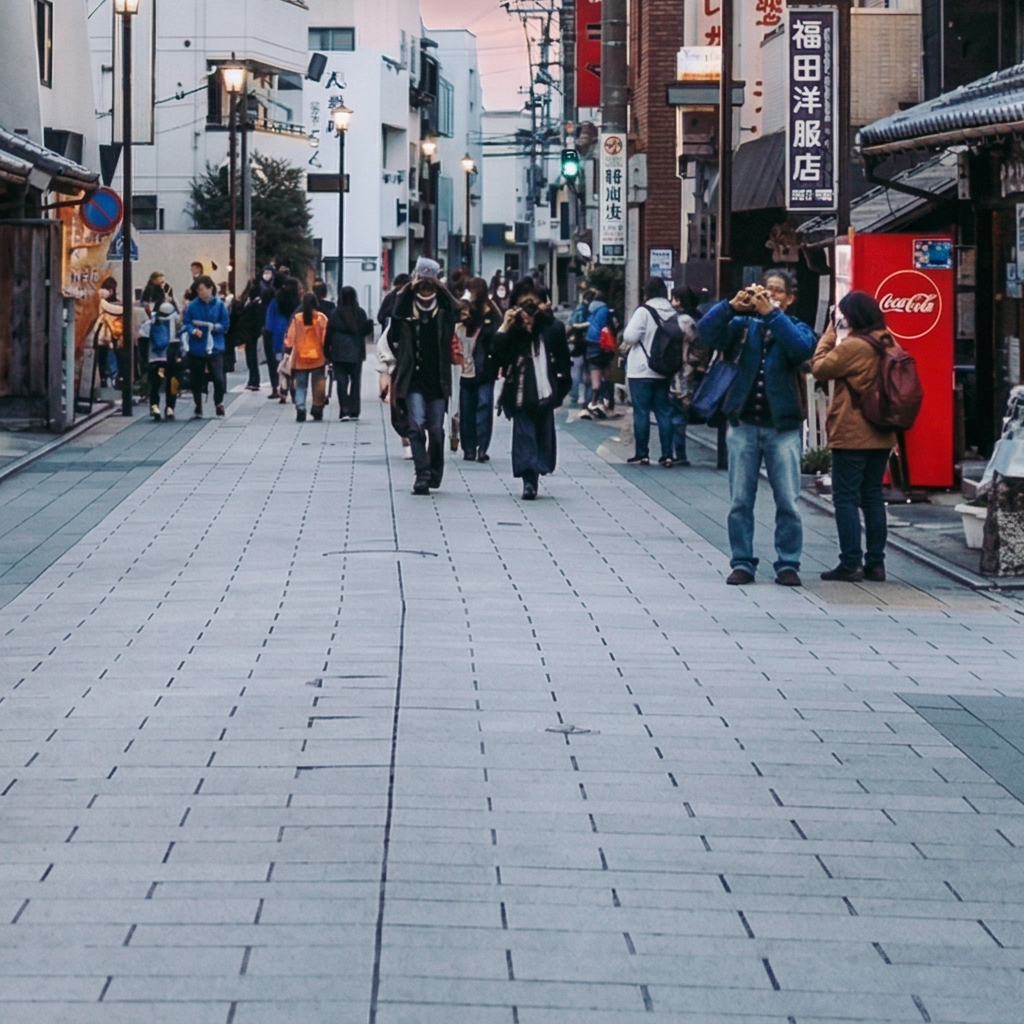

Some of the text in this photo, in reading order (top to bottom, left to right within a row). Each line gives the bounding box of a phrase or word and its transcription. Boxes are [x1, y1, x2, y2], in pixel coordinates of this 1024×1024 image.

[792, 19, 822, 182] 福田洋服店
